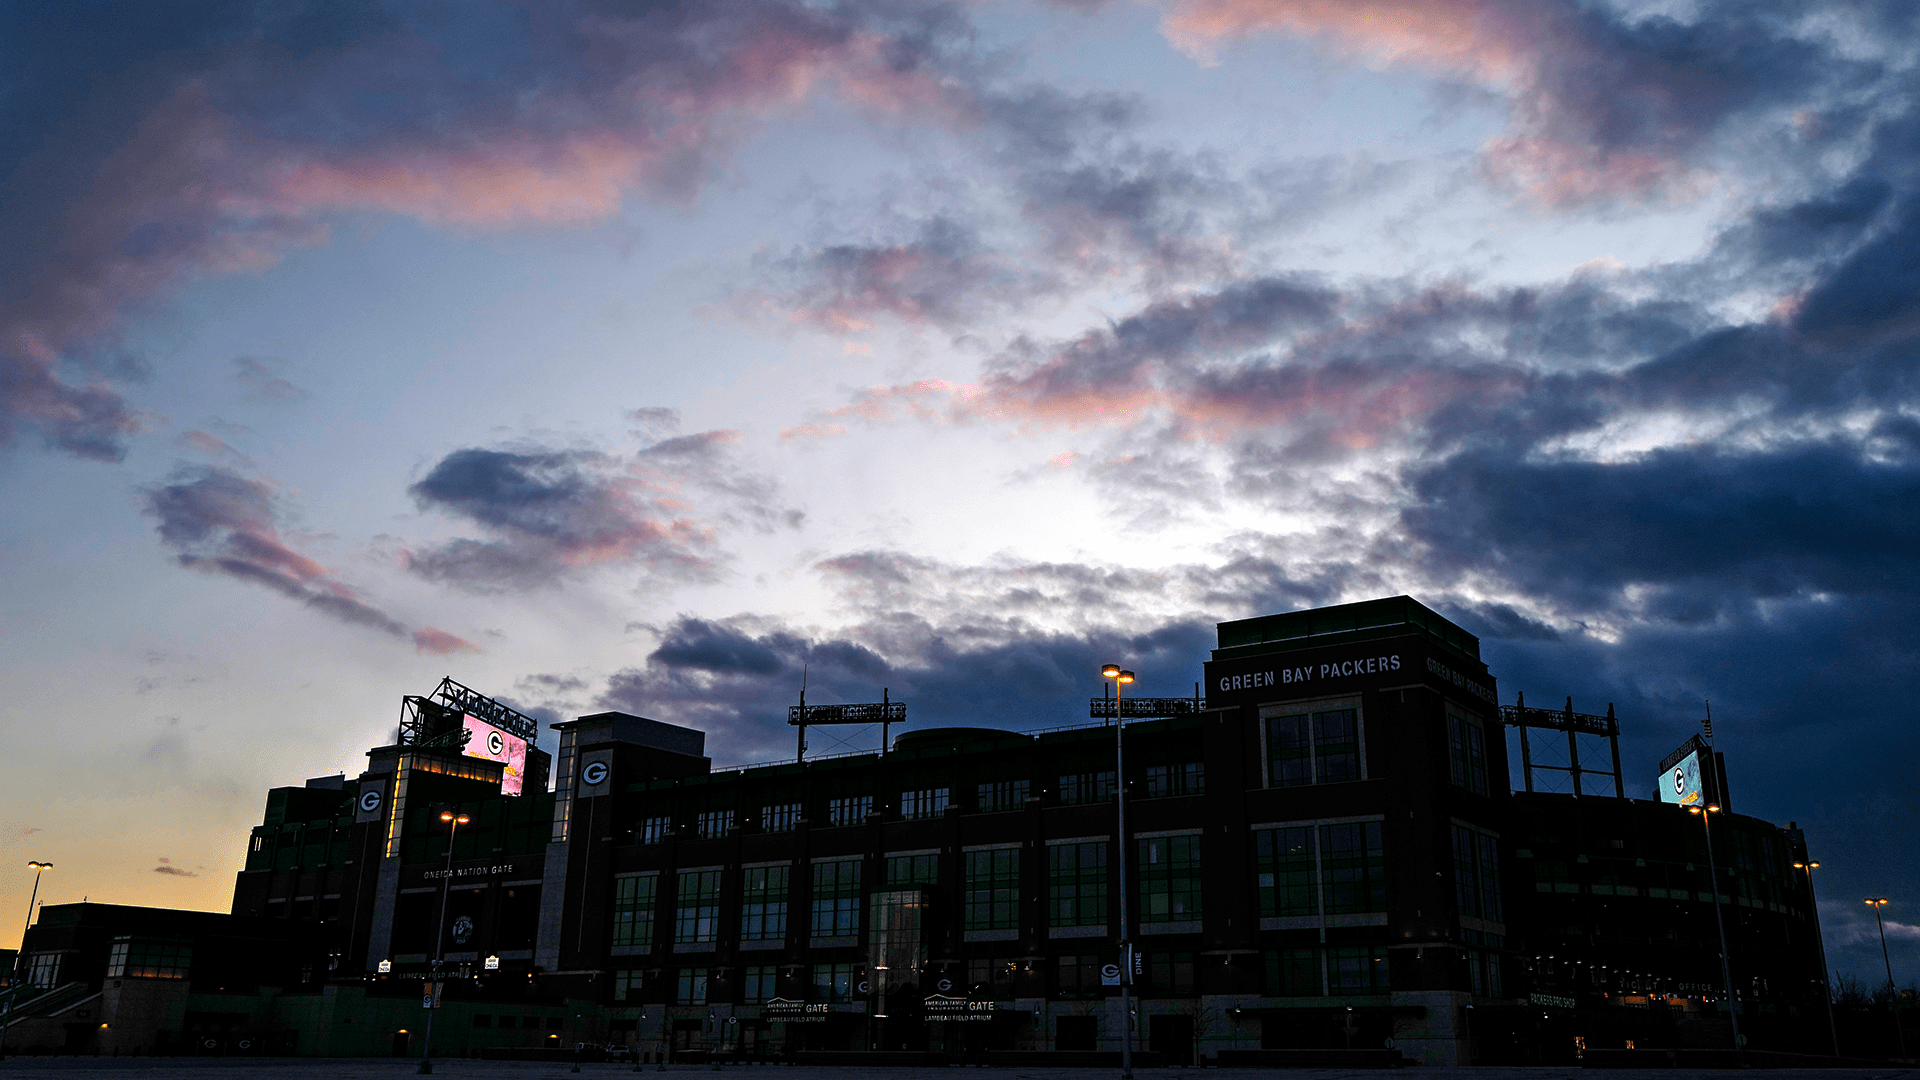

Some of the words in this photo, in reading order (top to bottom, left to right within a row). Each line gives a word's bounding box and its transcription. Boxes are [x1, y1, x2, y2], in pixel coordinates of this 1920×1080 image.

[1219, 670, 1275, 692] GREEN
[1282, 666, 1314, 684] BAY
[1320, 654, 1401, 679] PACKERS
[1426, 656, 1451, 681] GREEN
[1466, 677, 1496, 705] PACKERS
[488, 730, 503, 755] G
[583, 762, 607, 784] G
[1674, 767, 1684, 795] G
[361, 791, 380, 811] G
[423, 869, 454, 880] ONEIDA
[457, 866, 489, 877] NATION
[491, 864, 514, 875] GATE
[1101, 964, 1120, 977] G
[937, 979, 952, 991] G
[1678, 982, 1713, 992] OFFICE
[805, 1003, 829, 1013] GATE
[969, 1001, 995, 1011] GATE
